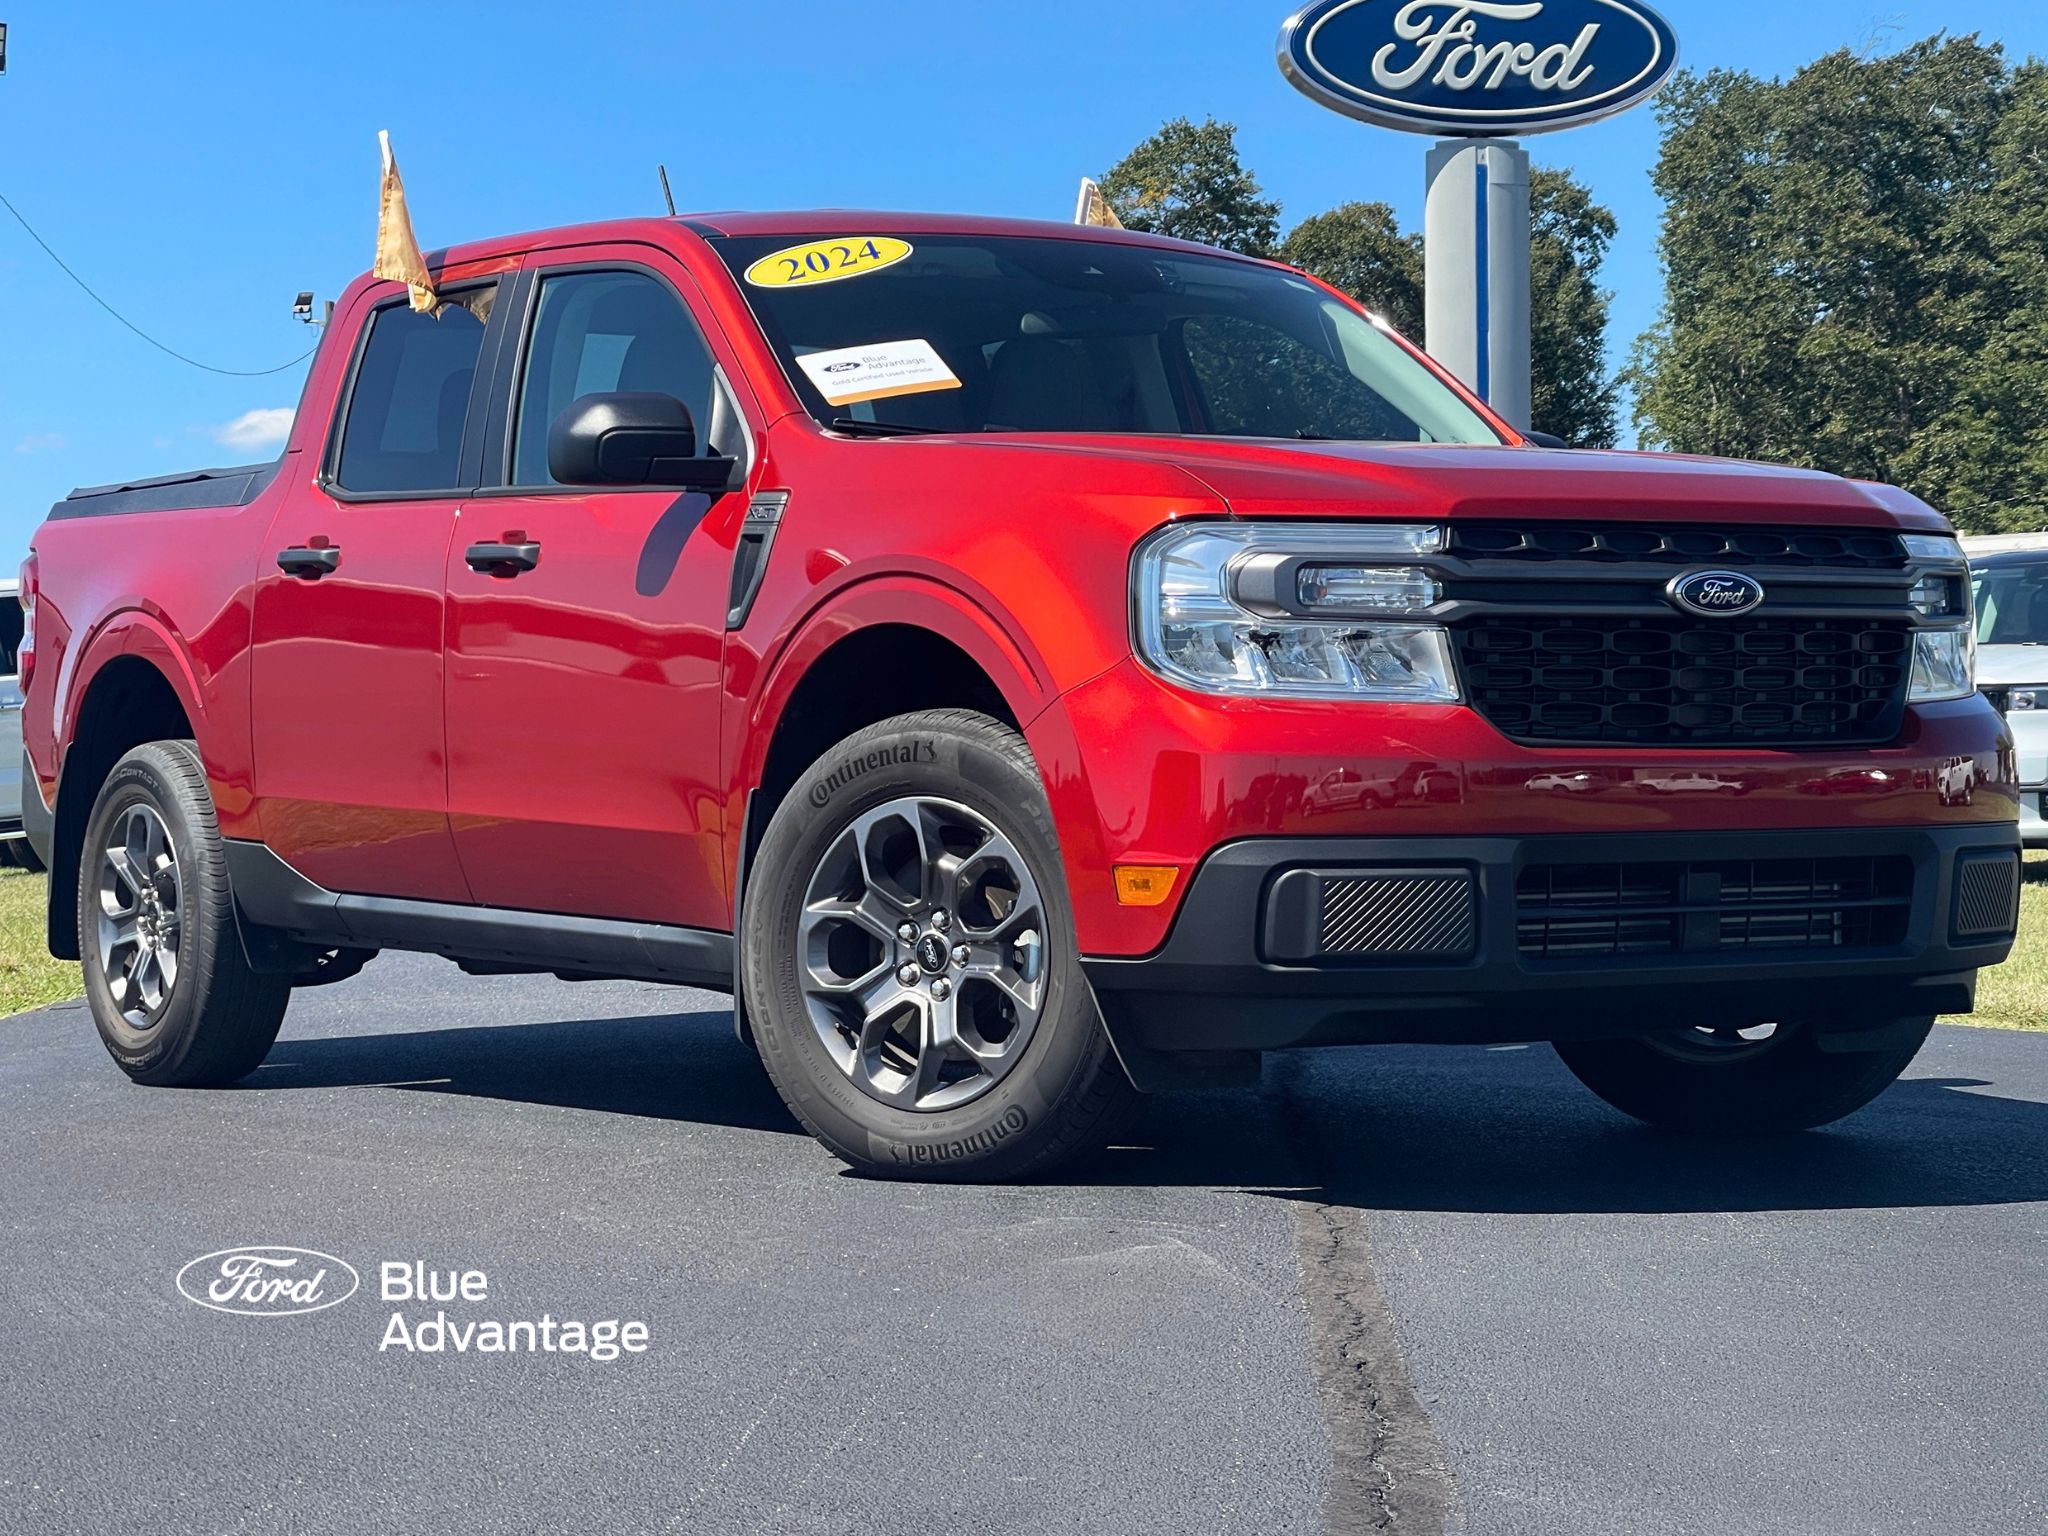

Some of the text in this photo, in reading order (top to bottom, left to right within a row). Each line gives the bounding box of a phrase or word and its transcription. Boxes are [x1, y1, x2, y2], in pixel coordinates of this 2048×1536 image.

[1371, 0, 1601, 91] Ford
[778, 239, 881, 281] 2024
[861, 354, 888, 365] Blue
[868, 357, 926, 370] Advantage
[1699, 579, 1746, 605] Ford
[808, 740, 920, 808] Continental
[908, 1104, 1029, 1166] Continental
